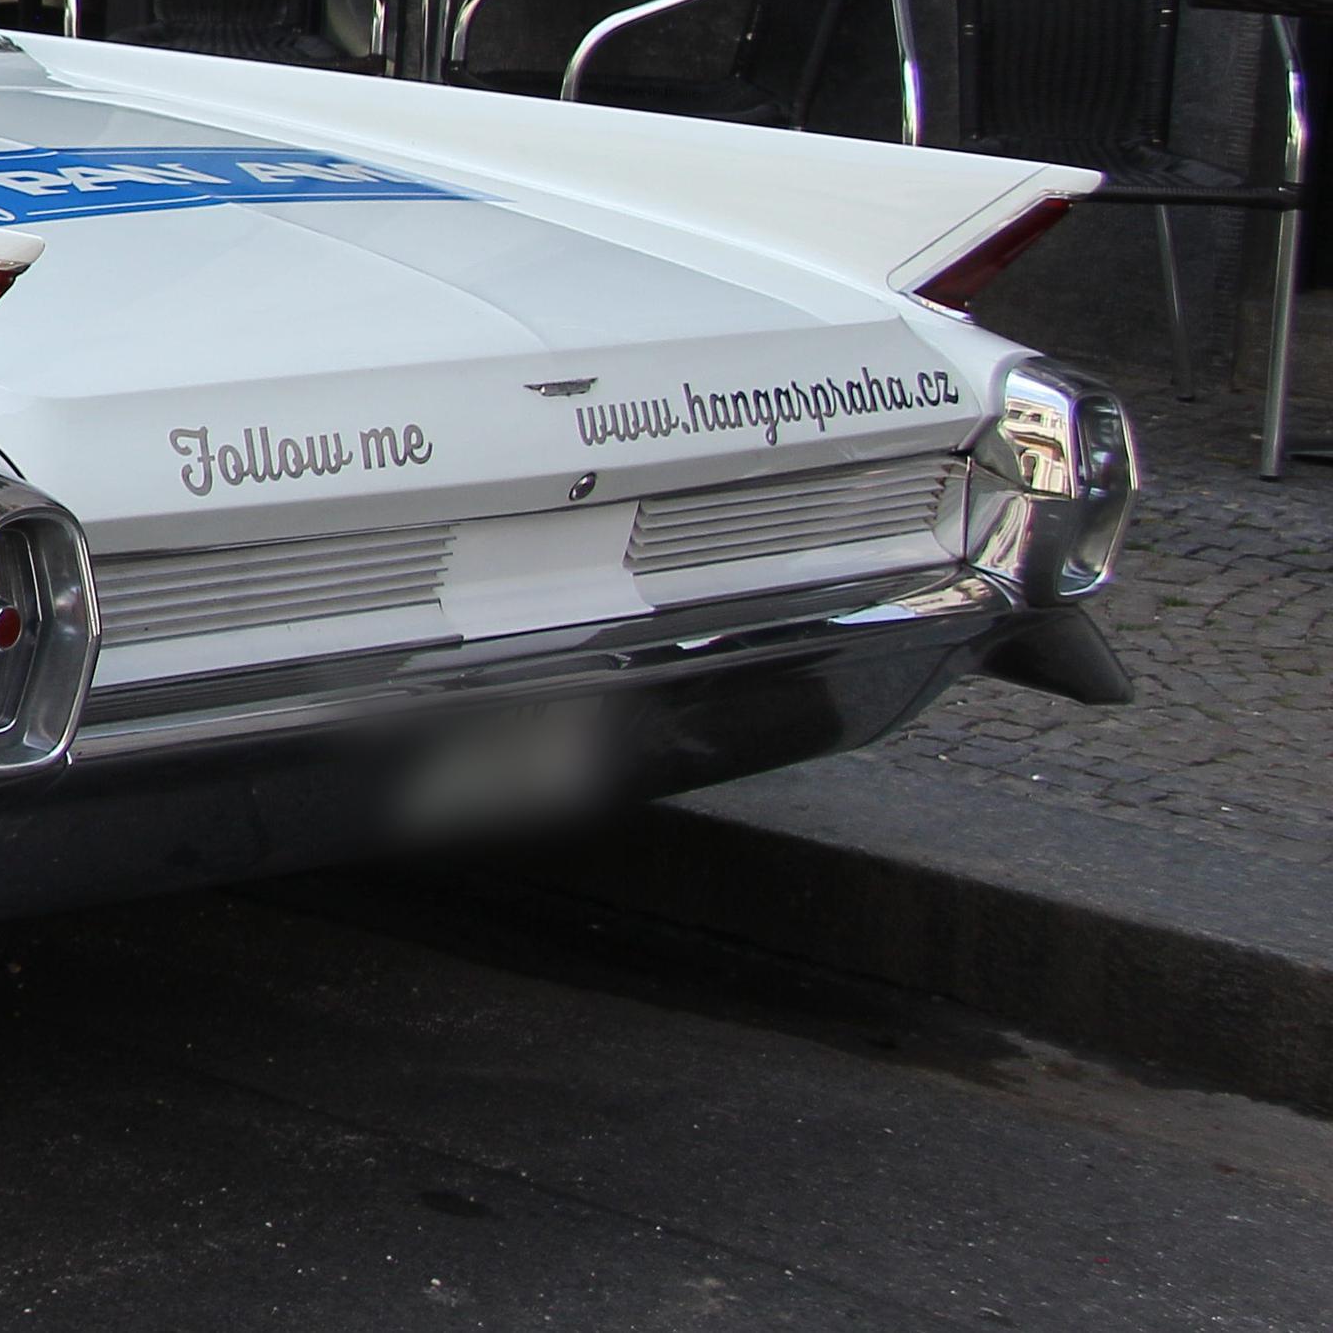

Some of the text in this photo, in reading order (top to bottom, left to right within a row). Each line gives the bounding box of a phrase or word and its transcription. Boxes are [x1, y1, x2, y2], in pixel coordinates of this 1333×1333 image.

[235, 161, 423, 185] AM
[169, 366, 960, 496] Follow me www.hangarpraha.cz
